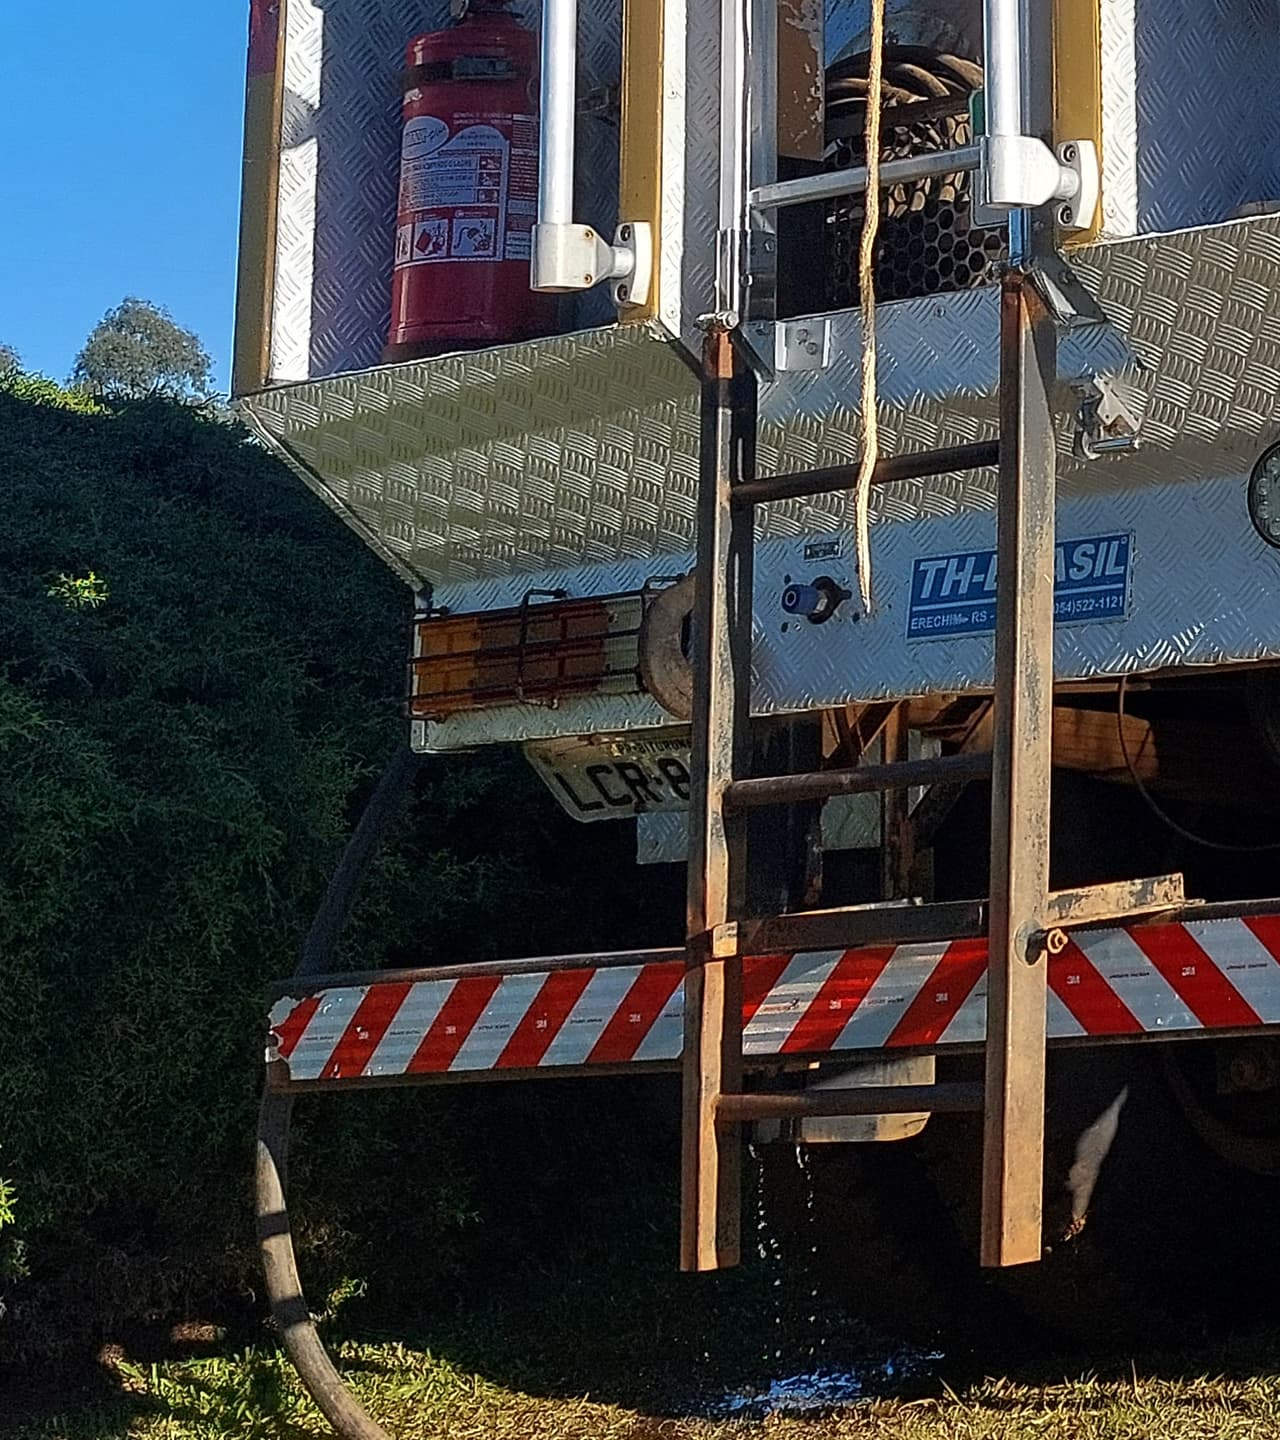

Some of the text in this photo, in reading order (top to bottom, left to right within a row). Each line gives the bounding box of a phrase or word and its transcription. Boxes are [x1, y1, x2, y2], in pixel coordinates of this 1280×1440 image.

[918, 539, 1125, 599] TH-ASIL
[971, 610, 987, 624] RS
[1182, 966, 1196, 977] 3M
